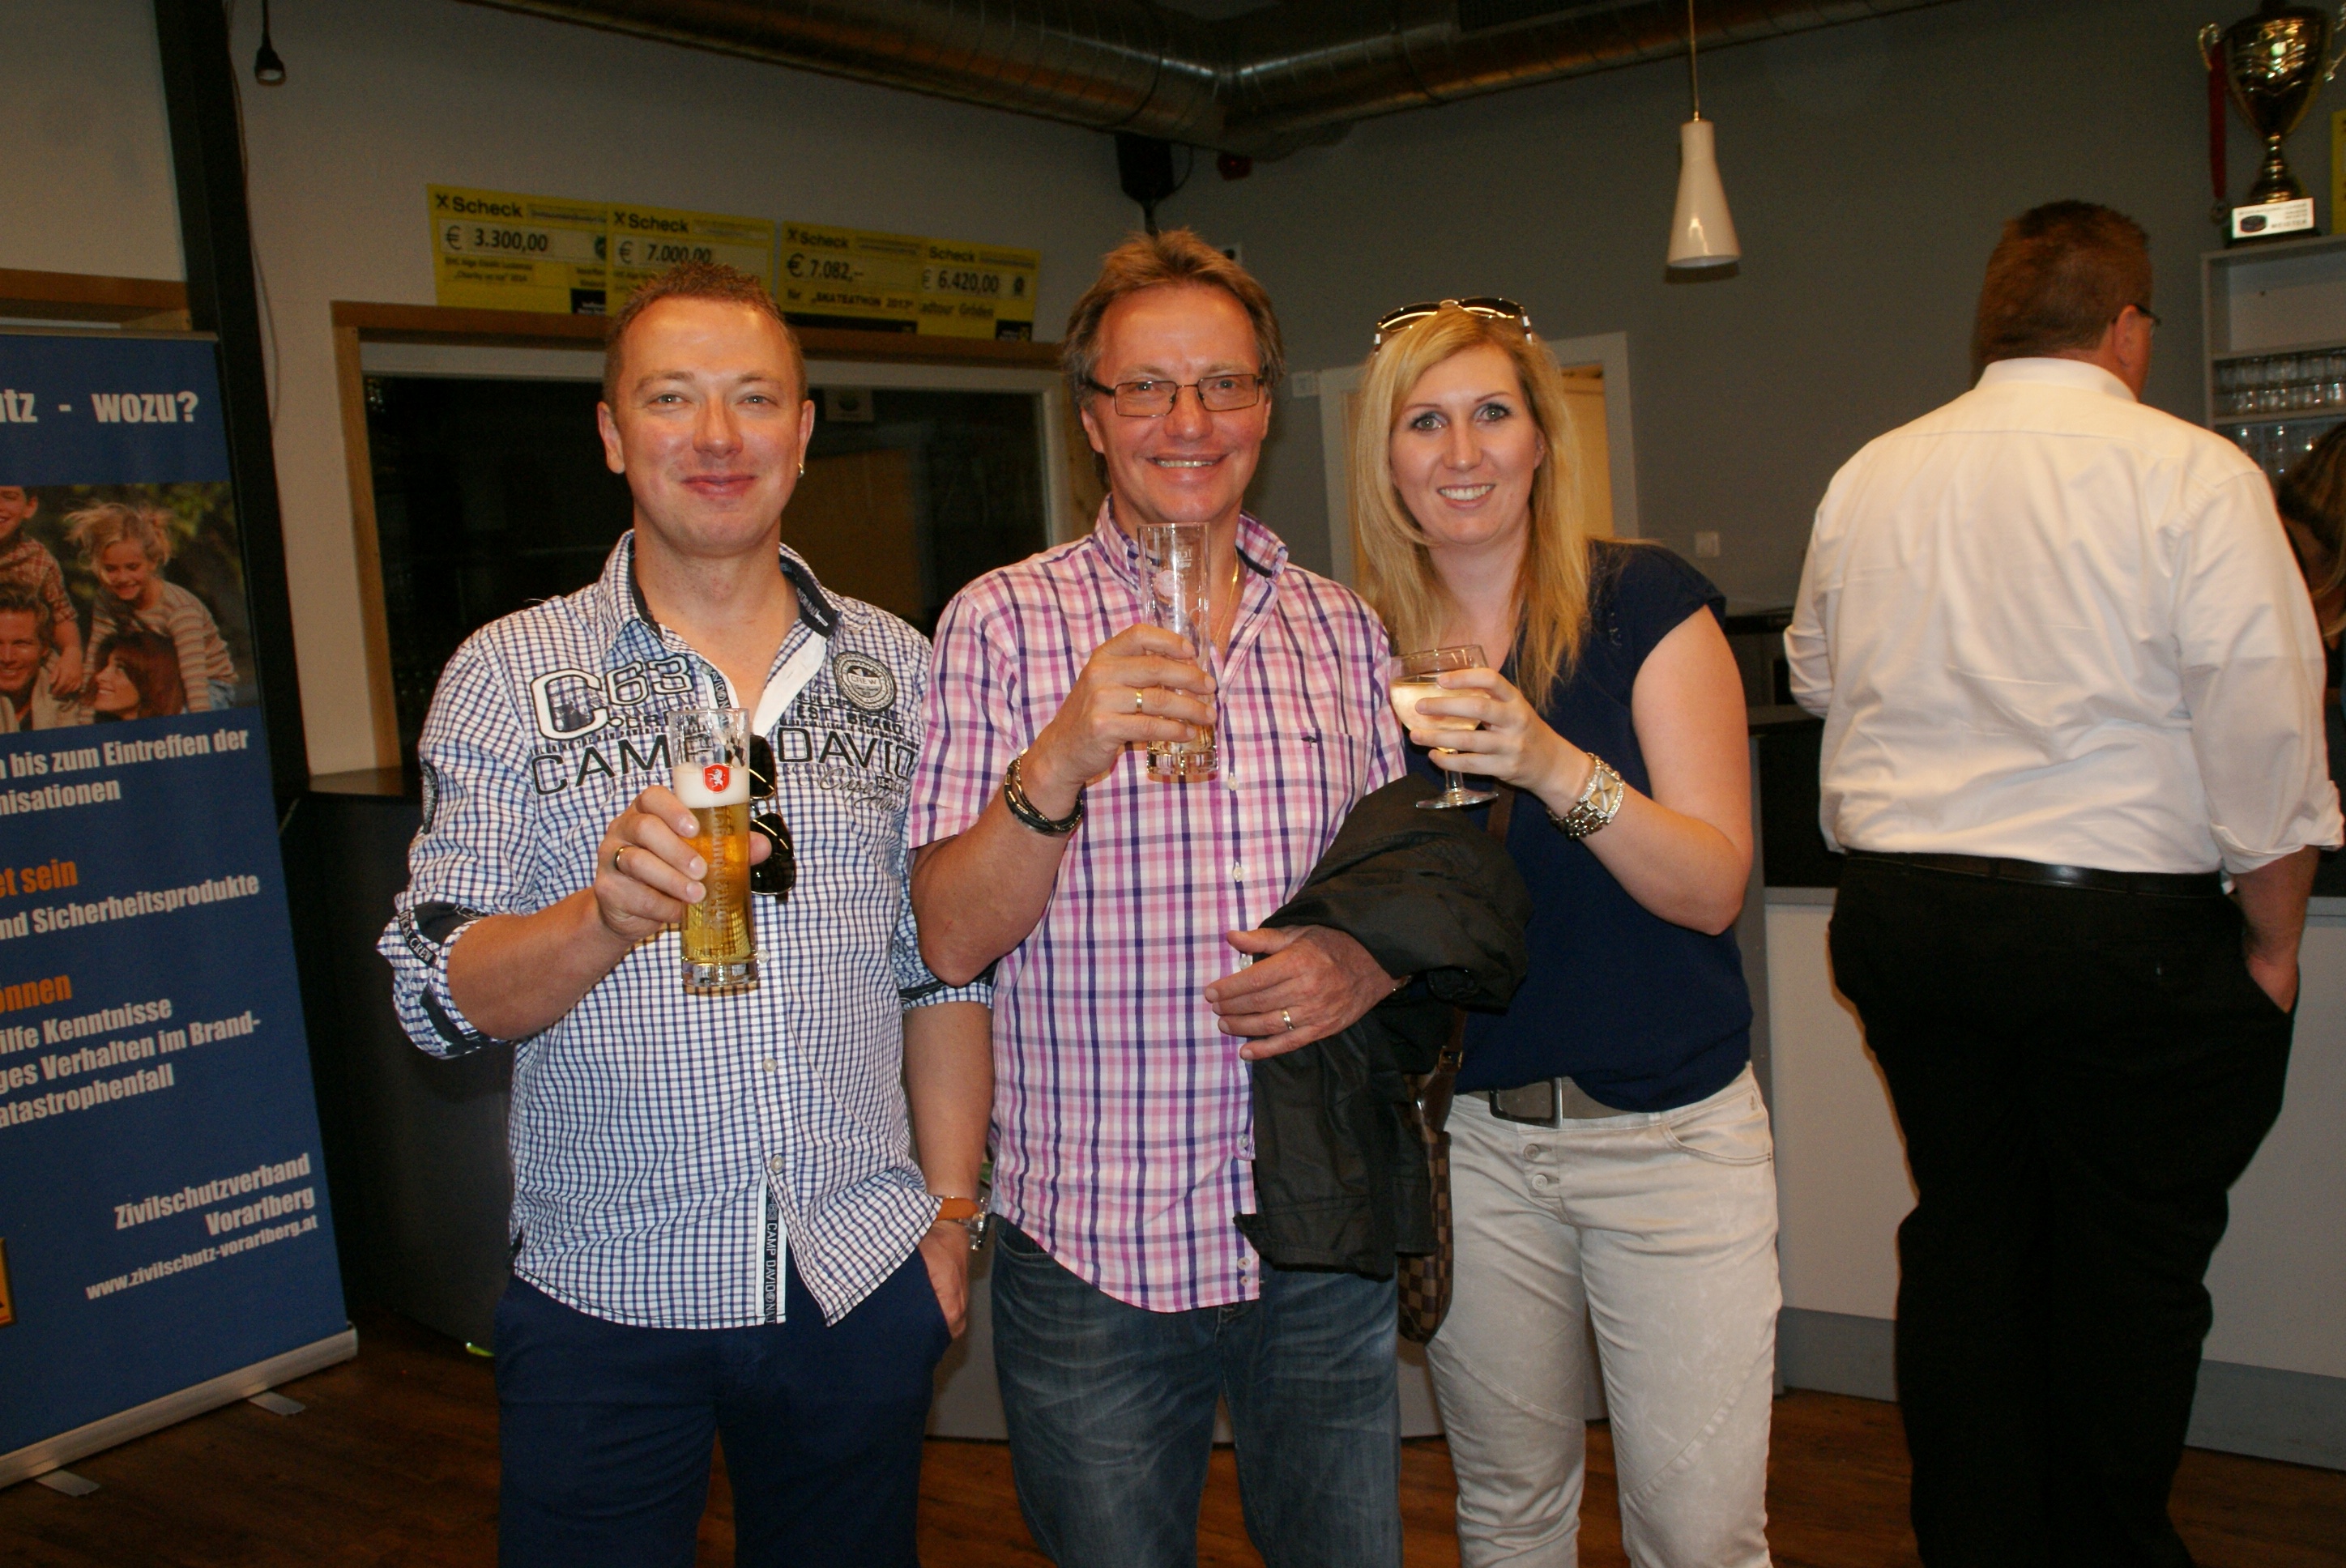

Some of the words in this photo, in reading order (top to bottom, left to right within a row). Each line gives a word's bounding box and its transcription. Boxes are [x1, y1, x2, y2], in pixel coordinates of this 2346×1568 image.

[452, 196, 523, 218] Scheck
[446, 225, 463, 250] €
[474, 228, 549, 253] 3.300,00
[629, 214, 689, 233] Scheck
[618, 241, 633, 264] €
[800, 232, 849, 249] Scheck
[929, 246, 975, 263] Scheck
[787, 253, 805, 278] €
[938, 268, 1000, 294] 6.420,00
[91, 391, 199, 423] wozu?
[850, 674, 877, 686] CREW
[847, 710, 904, 735] BRAND
[10, 752, 48, 778] bis
[51, 746, 100, 773] zum
[102, 734, 211, 767] Eintreffen
[213, 729, 250, 752] der
[777, 726, 917, 781] DAVID
[22, 858, 79, 893] sein
[32, 874, 261, 935] Sicherheitsprodukte
[42, 997, 173, 1045] Kenntnisse
[41, 1036, 156, 1081] Verhalten
[157, 1028, 187, 1054] im
[189, 1009, 262, 1046] Brand-
[113, 1152, 311, 1231] Zivilschutzverband
[205, 1187, 316, 1237] Vorarlberg
[766, 1222, 778, 1256] CAMP
[84, 1214, 319, 1301] www.zivilschutz-vorarlberg.at
[765, 1260, 777, 1293] DAVID
